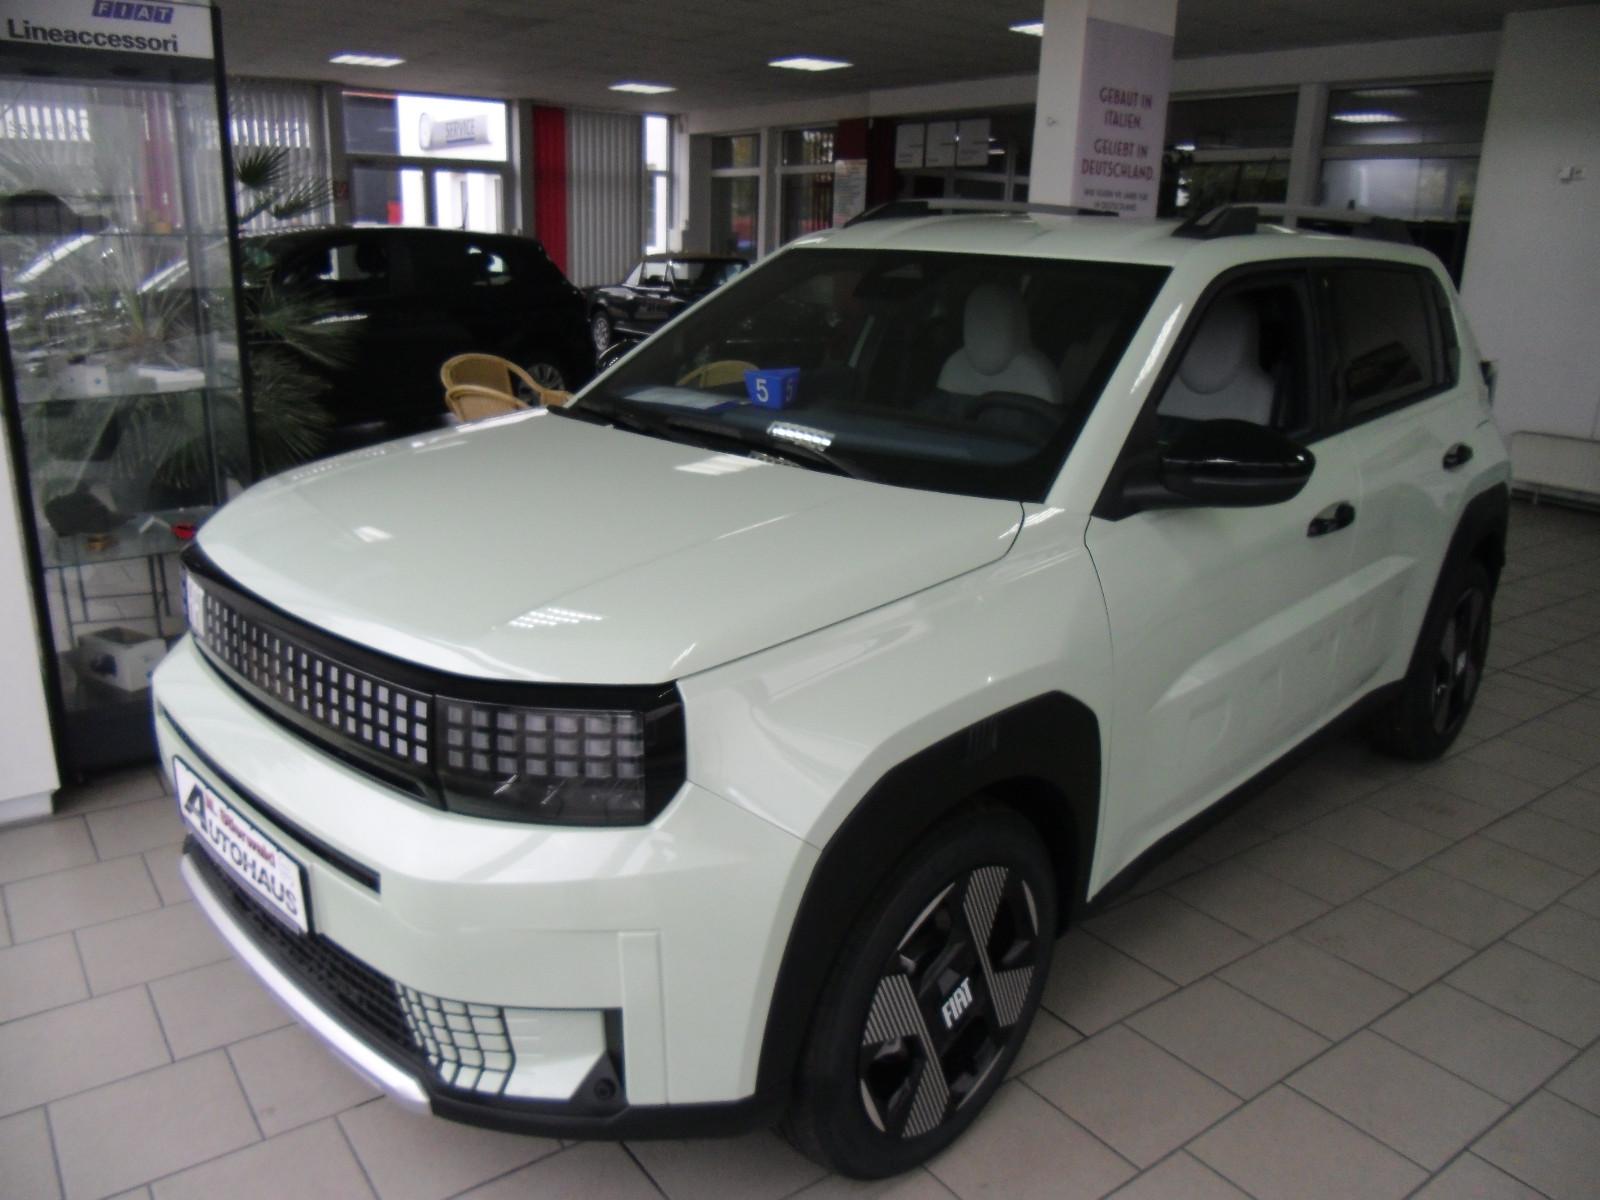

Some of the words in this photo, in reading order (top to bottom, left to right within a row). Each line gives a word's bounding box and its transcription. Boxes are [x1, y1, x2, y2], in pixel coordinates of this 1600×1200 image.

[93, 1, 171, 22] FIAT
[7, 18, 179, 52] Lineaccessori
[1100, 87, 1139, 107] GEBAUT
[1141, 94, 1152, 109] IN
[1094, 139, 1135, 158] GELIEBT
[1137, 144, 1148, 159] IN
[756, 378, 769, 402] 5
[184, 783, 298, 916] AUTOHAUS
[942, 976, 972, 1028] FIAT
